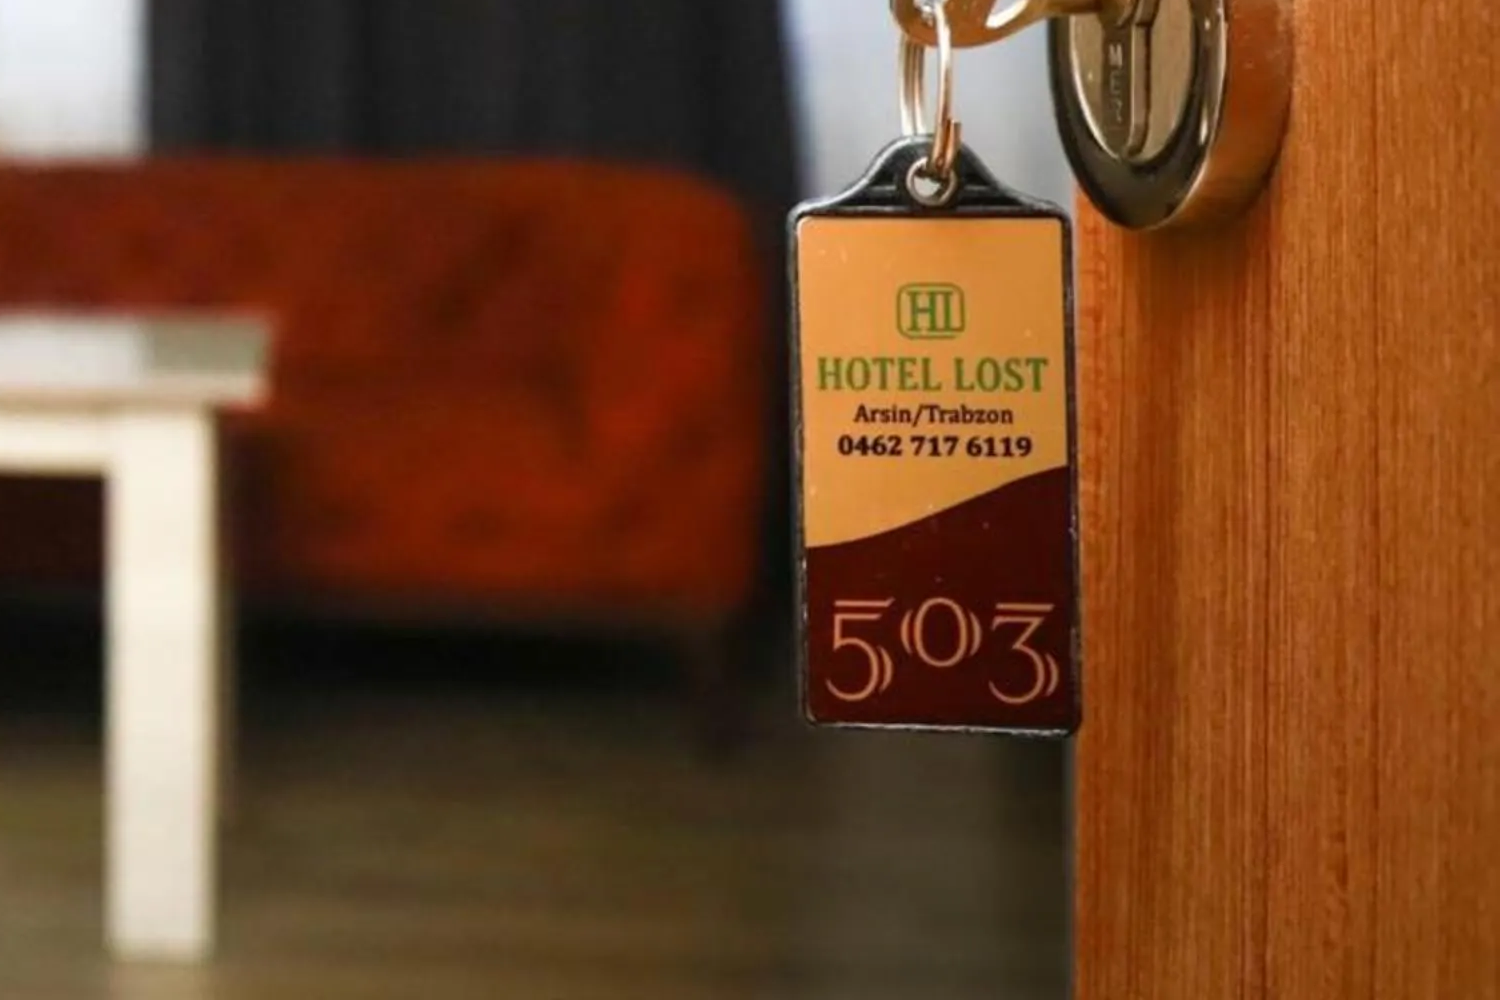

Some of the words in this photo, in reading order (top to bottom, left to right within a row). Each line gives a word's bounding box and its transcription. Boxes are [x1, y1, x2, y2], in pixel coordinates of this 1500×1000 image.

[817, 356, 942, 392] HOTEL
[954, 356, 1049, 393] LOST
[853, 404, 1013, 428] Arsin/Trabzon
[837, 434, 903, 457] 0462
[910, 435, 959, 457] 717
[966, 435, 1033, 458] 6119
[825, 597, 1059, 704] 503
